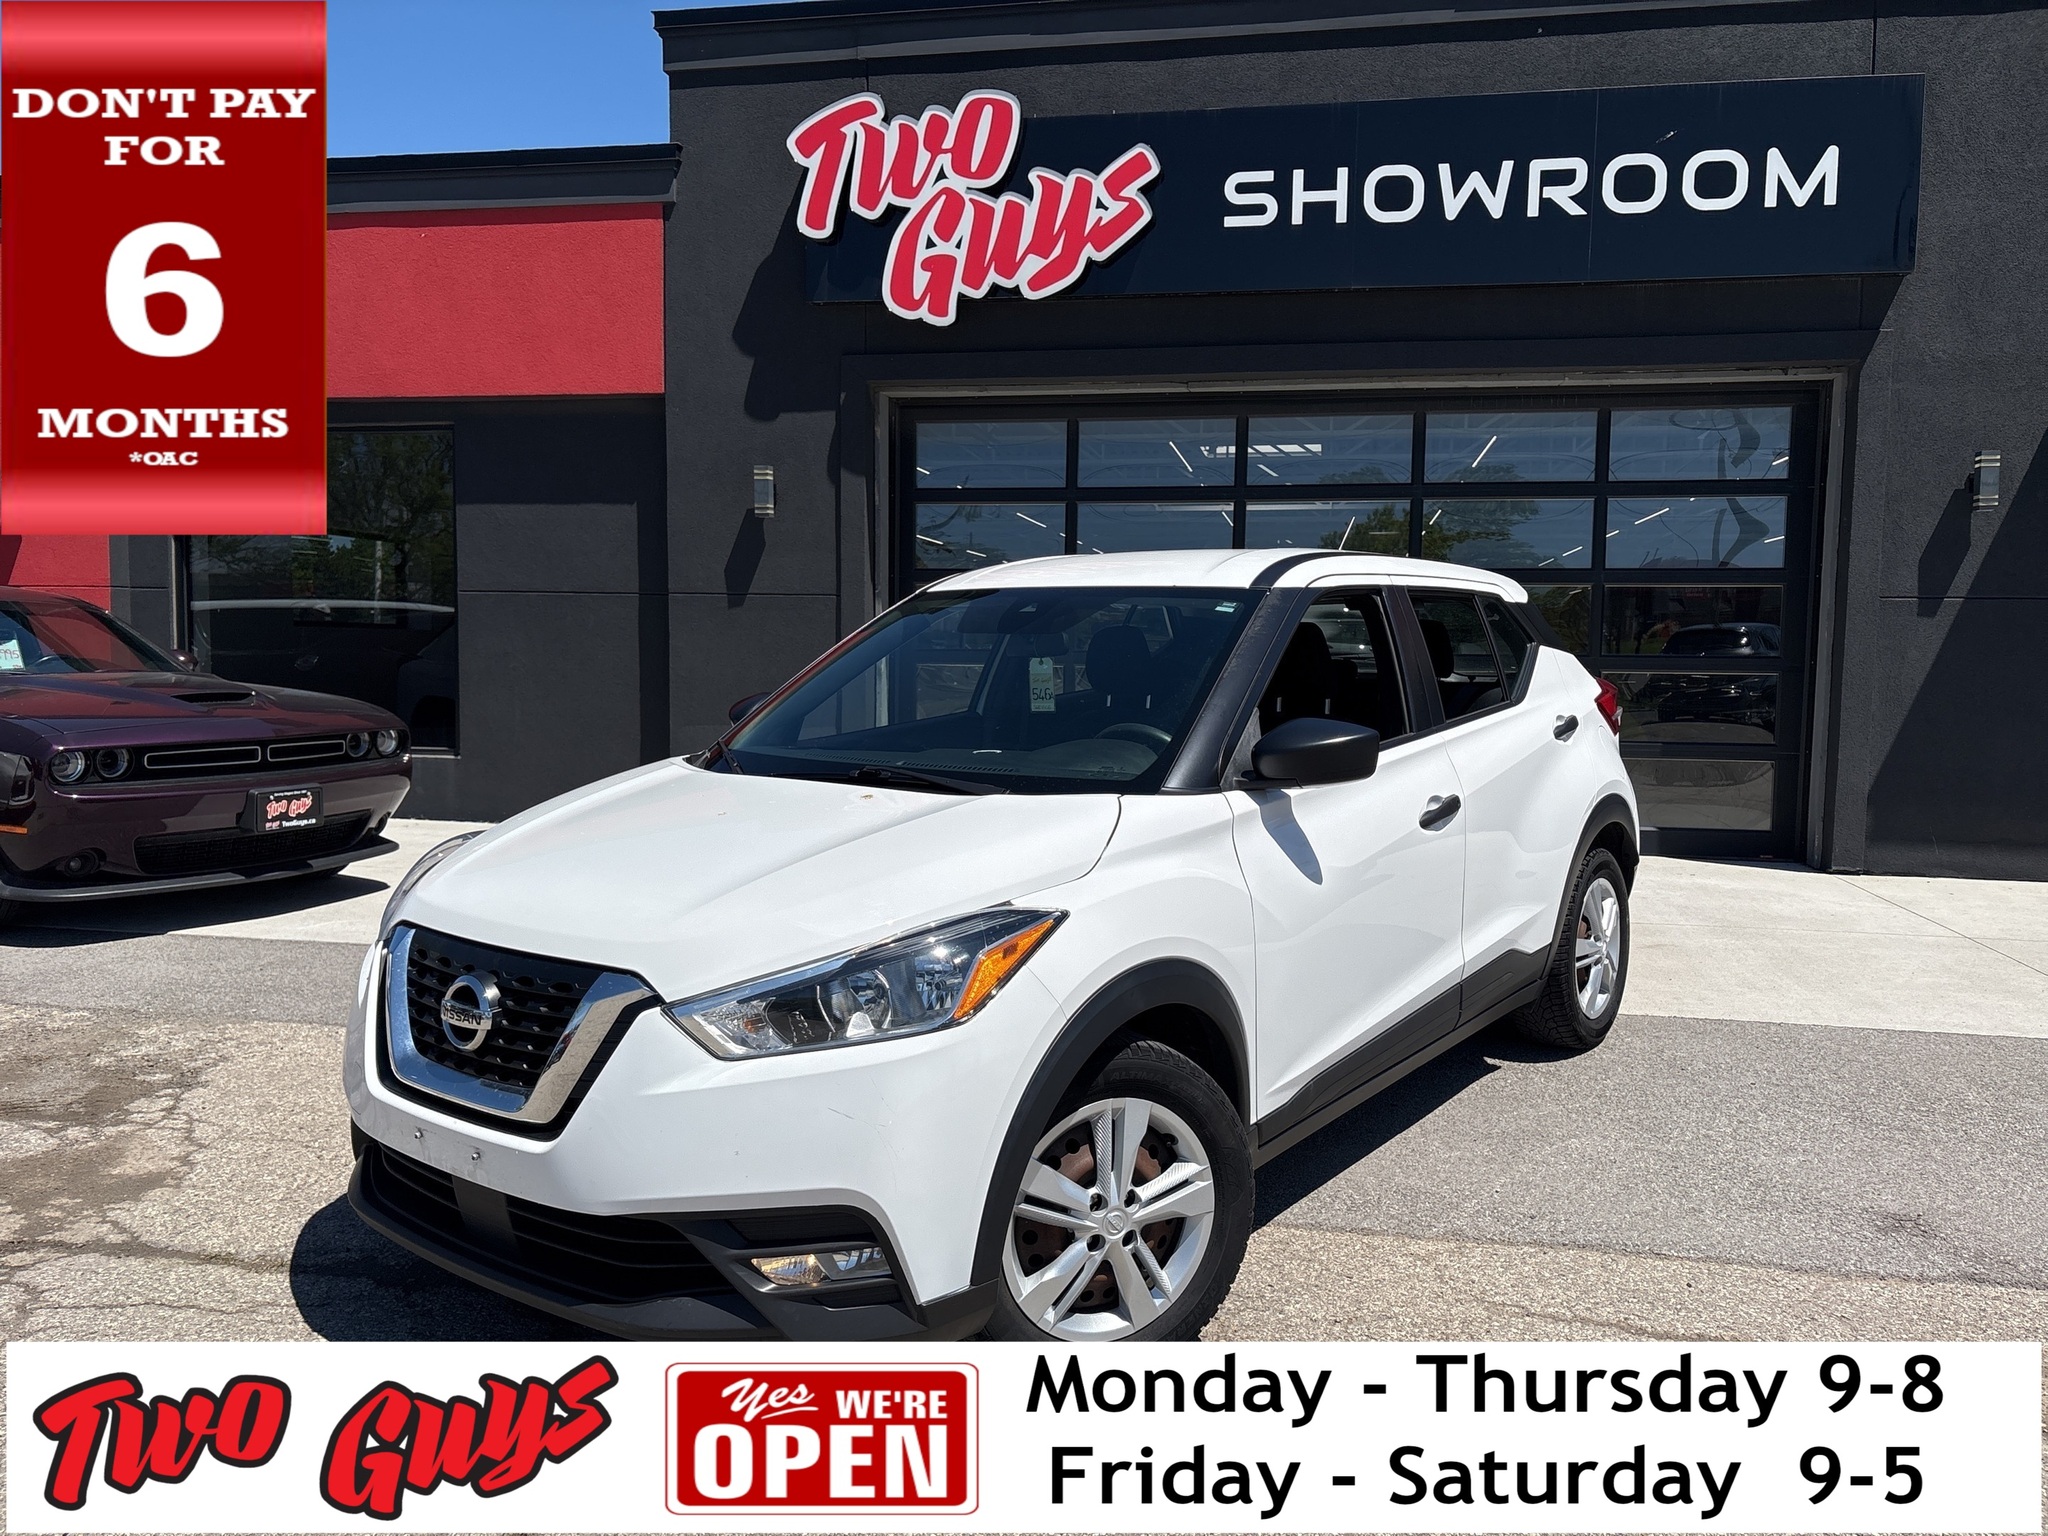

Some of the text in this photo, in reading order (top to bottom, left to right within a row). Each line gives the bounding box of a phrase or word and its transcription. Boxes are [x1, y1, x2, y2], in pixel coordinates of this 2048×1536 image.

[790, 92, 1018, 236] Two
[1222, 144, 1841, 229] SHOWROOM
[886, 147, 1156, 322] Guys
[442, 1001, 483, 1026] NISSAN
